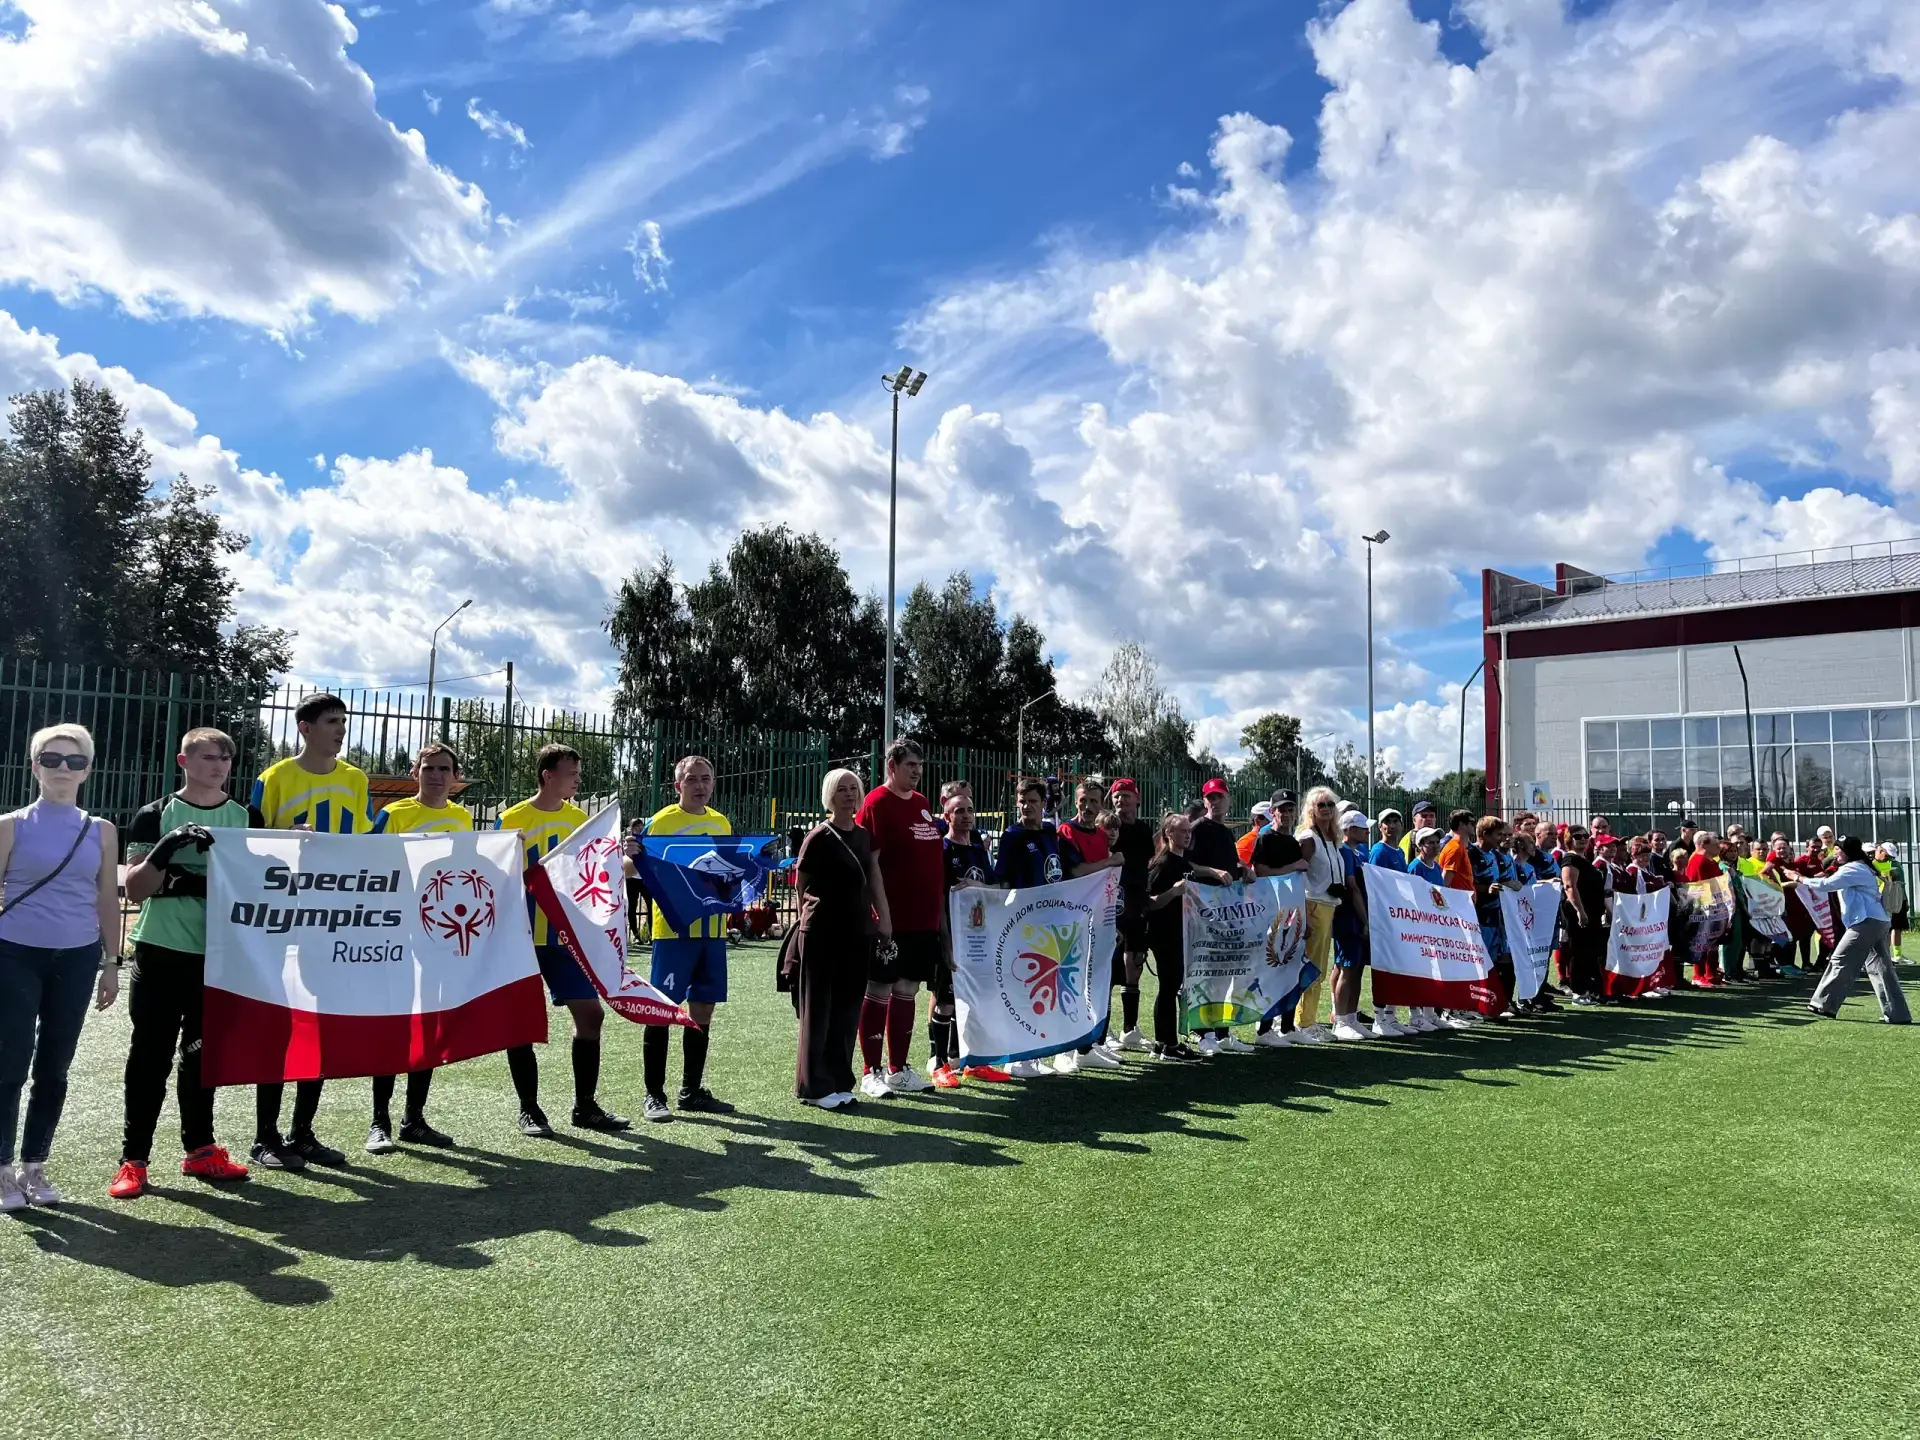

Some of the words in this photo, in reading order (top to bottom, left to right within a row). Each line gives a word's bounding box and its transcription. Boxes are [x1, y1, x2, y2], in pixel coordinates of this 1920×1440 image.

[264, 866, 400, 896] Special
[231, 902, 402, 933] Olympics
[1015, 903, 1034, 921] ДОМ
[1036, 899, 1094, 918] СОЦИАЛЬНОГ
[1389, 906, 1460, 928] ВЛАДИМИРСКАЯ
[559, 930, 569, 944] СО
[1401, 932, 1455, 949] МИНИСТЕРСТВО
[332, 940, 403, 963] Russia
[1420, 947, 1449, 960] ЗАЩИТЫ
[1450, 952, 1485, 965] НАСЕЛЕНИЯ
[663, 973, 675, 991] 4
[1000, 991, 1037, 1035] ГБУСОВО
